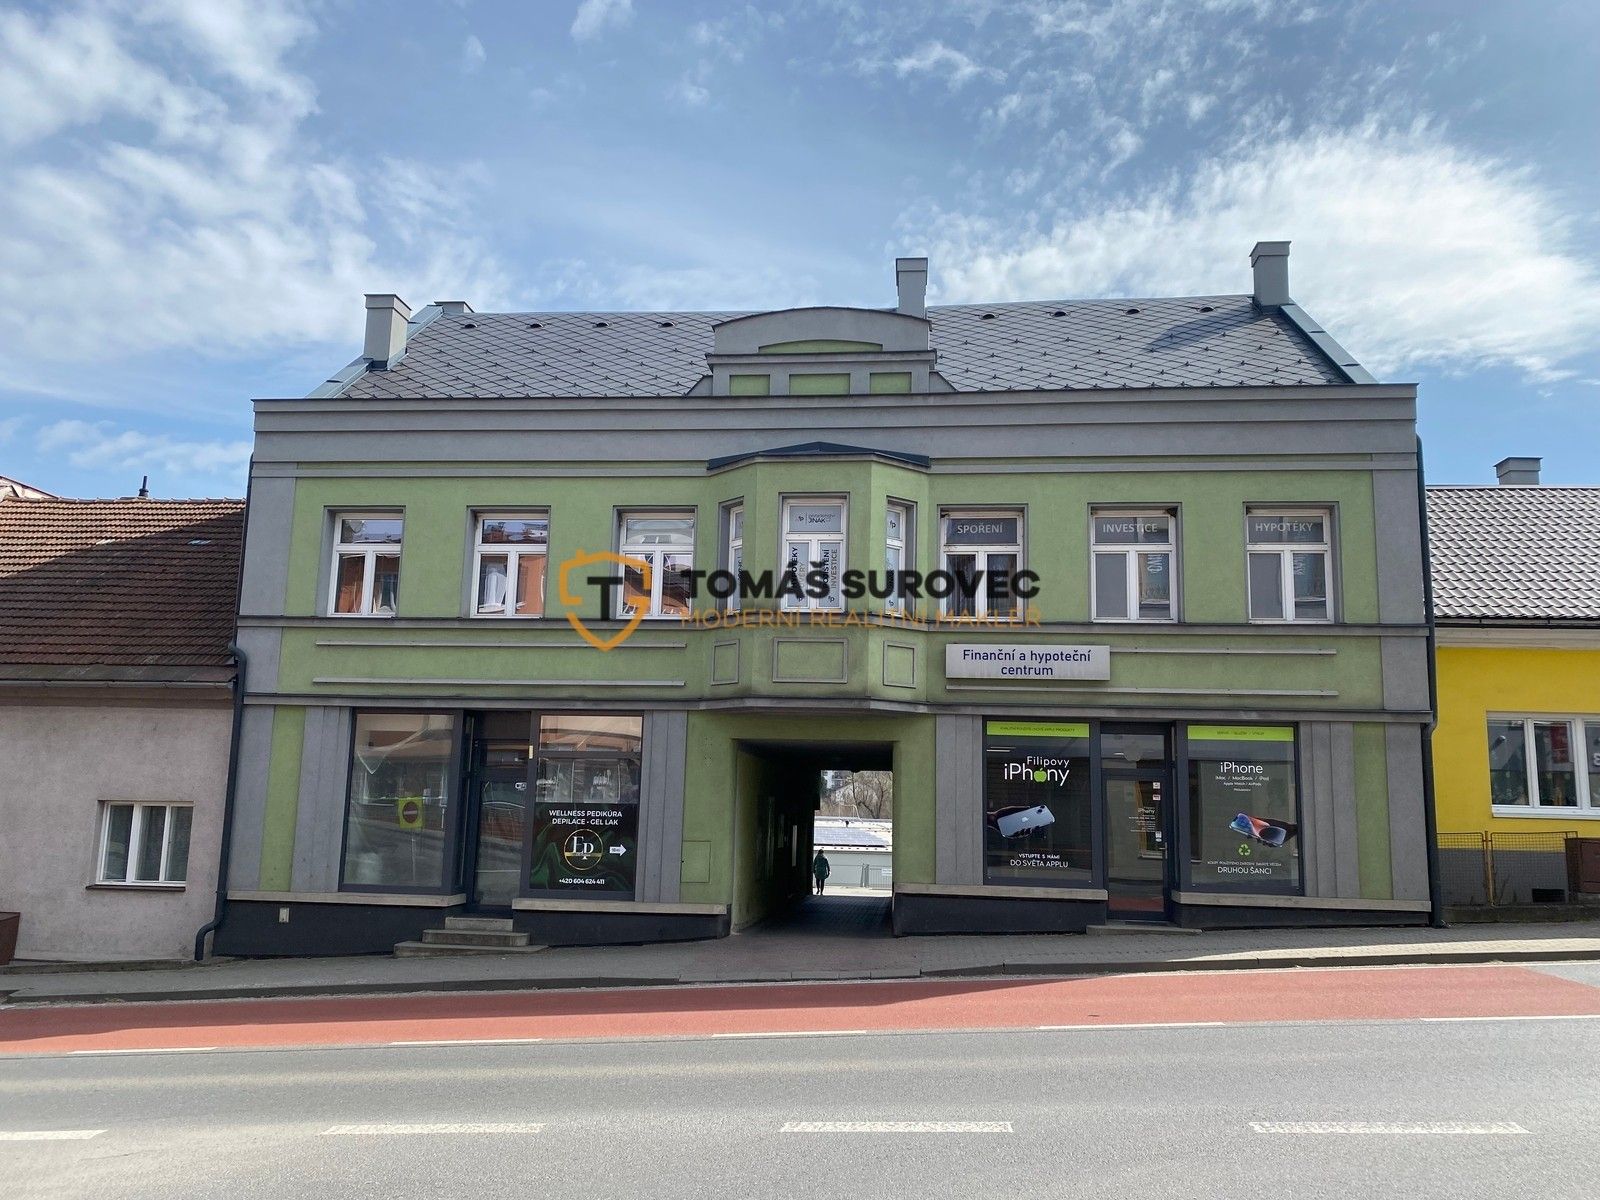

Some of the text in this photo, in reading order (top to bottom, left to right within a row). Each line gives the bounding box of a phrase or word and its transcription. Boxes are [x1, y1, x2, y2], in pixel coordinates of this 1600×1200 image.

[957, 523, 1003, 534] SPOŘENÍ
[1102, 523, 1158, 533] INVESTICE
[1255, 520, 1313, 532] HYPOTÉKY
[830, 549, 838, 589] INVESTICE
[963, 649, 1091, 663] Finanční a hypoteční
[1001, 664, 1053, 675] centrum
[1027, 756, 1069, 768] Filipovy
[1220, 761, 1263, 773] iPhone
[586, 809, 623, 817] PEDIKÚRA
[1022, 859, 1045, 867] SVĚTA
[1045, 860, 1069, 868] APPLU
[1217, 866, 1248, 874] DRUHOU
